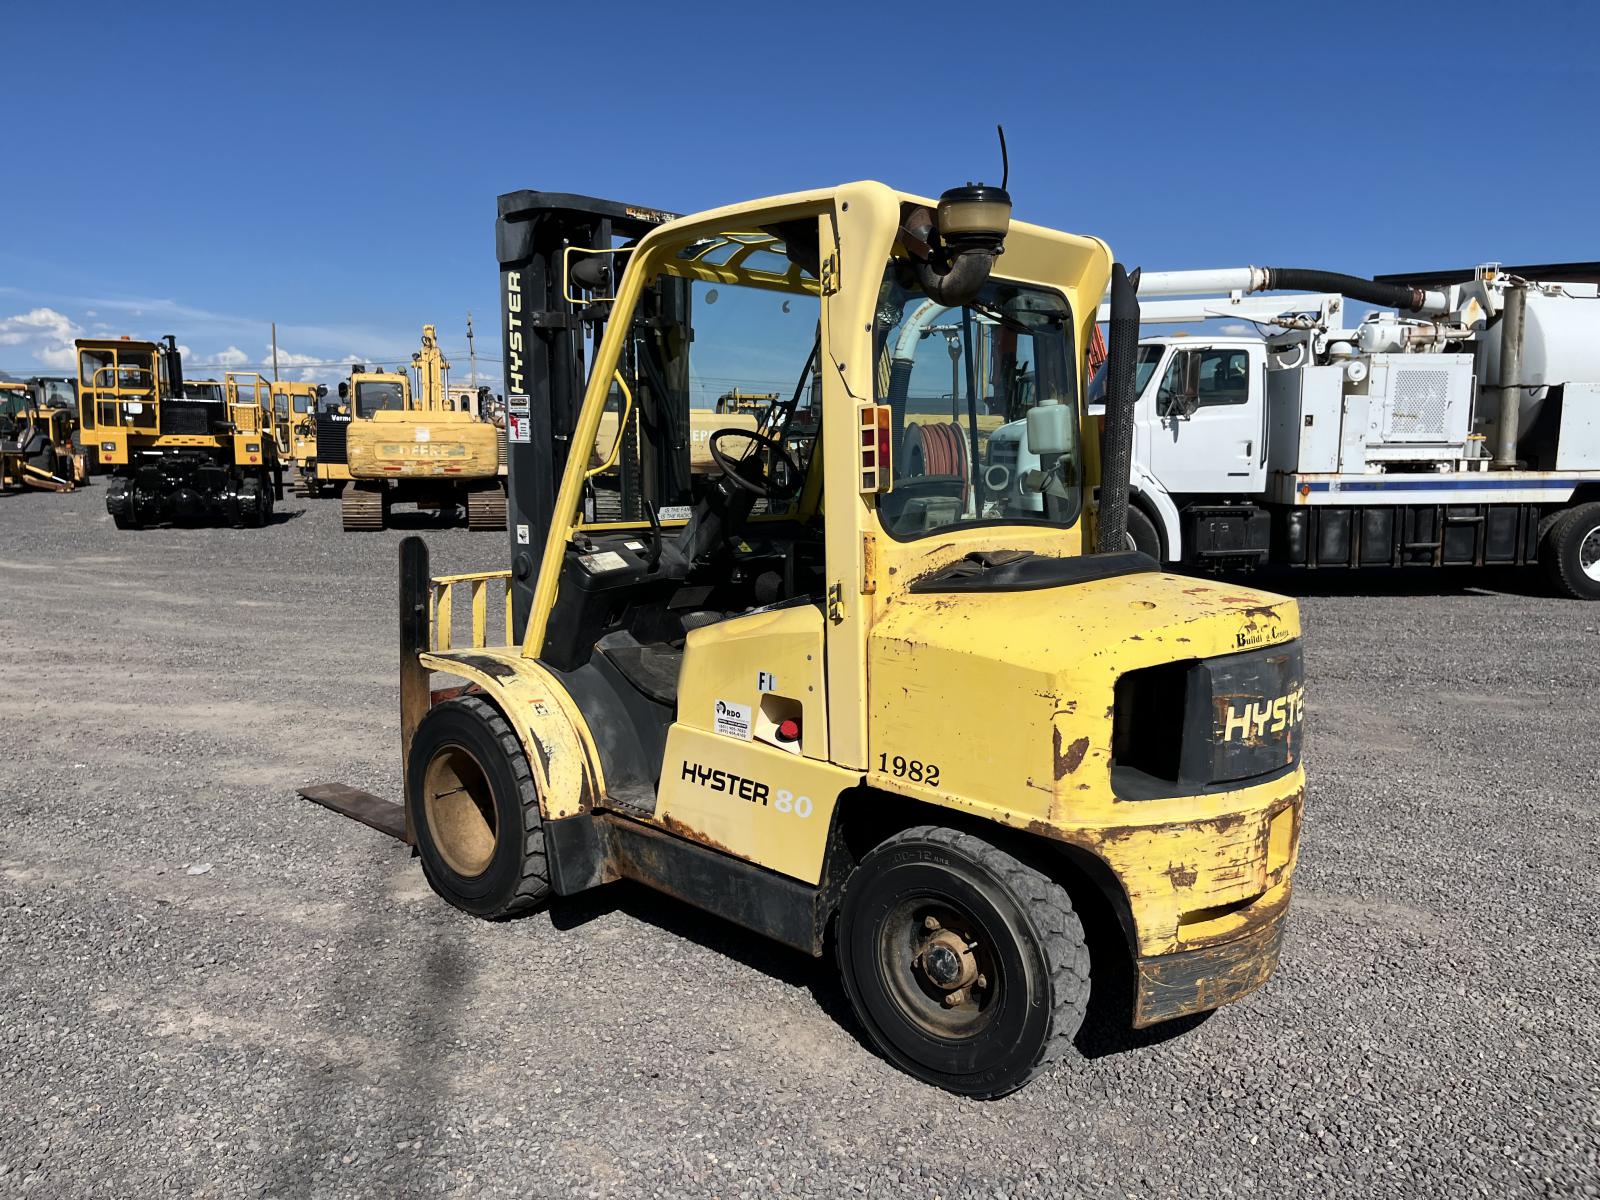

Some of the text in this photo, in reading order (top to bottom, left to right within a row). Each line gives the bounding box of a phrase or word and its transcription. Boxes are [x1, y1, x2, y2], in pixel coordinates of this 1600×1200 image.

[508, 271, 524, 394] HYSTER
[1224, 685, 1304, 741] HYSTE
[681, 760, 813, 818] HYSTER 80
[878, 752, 940, 787] 1982
